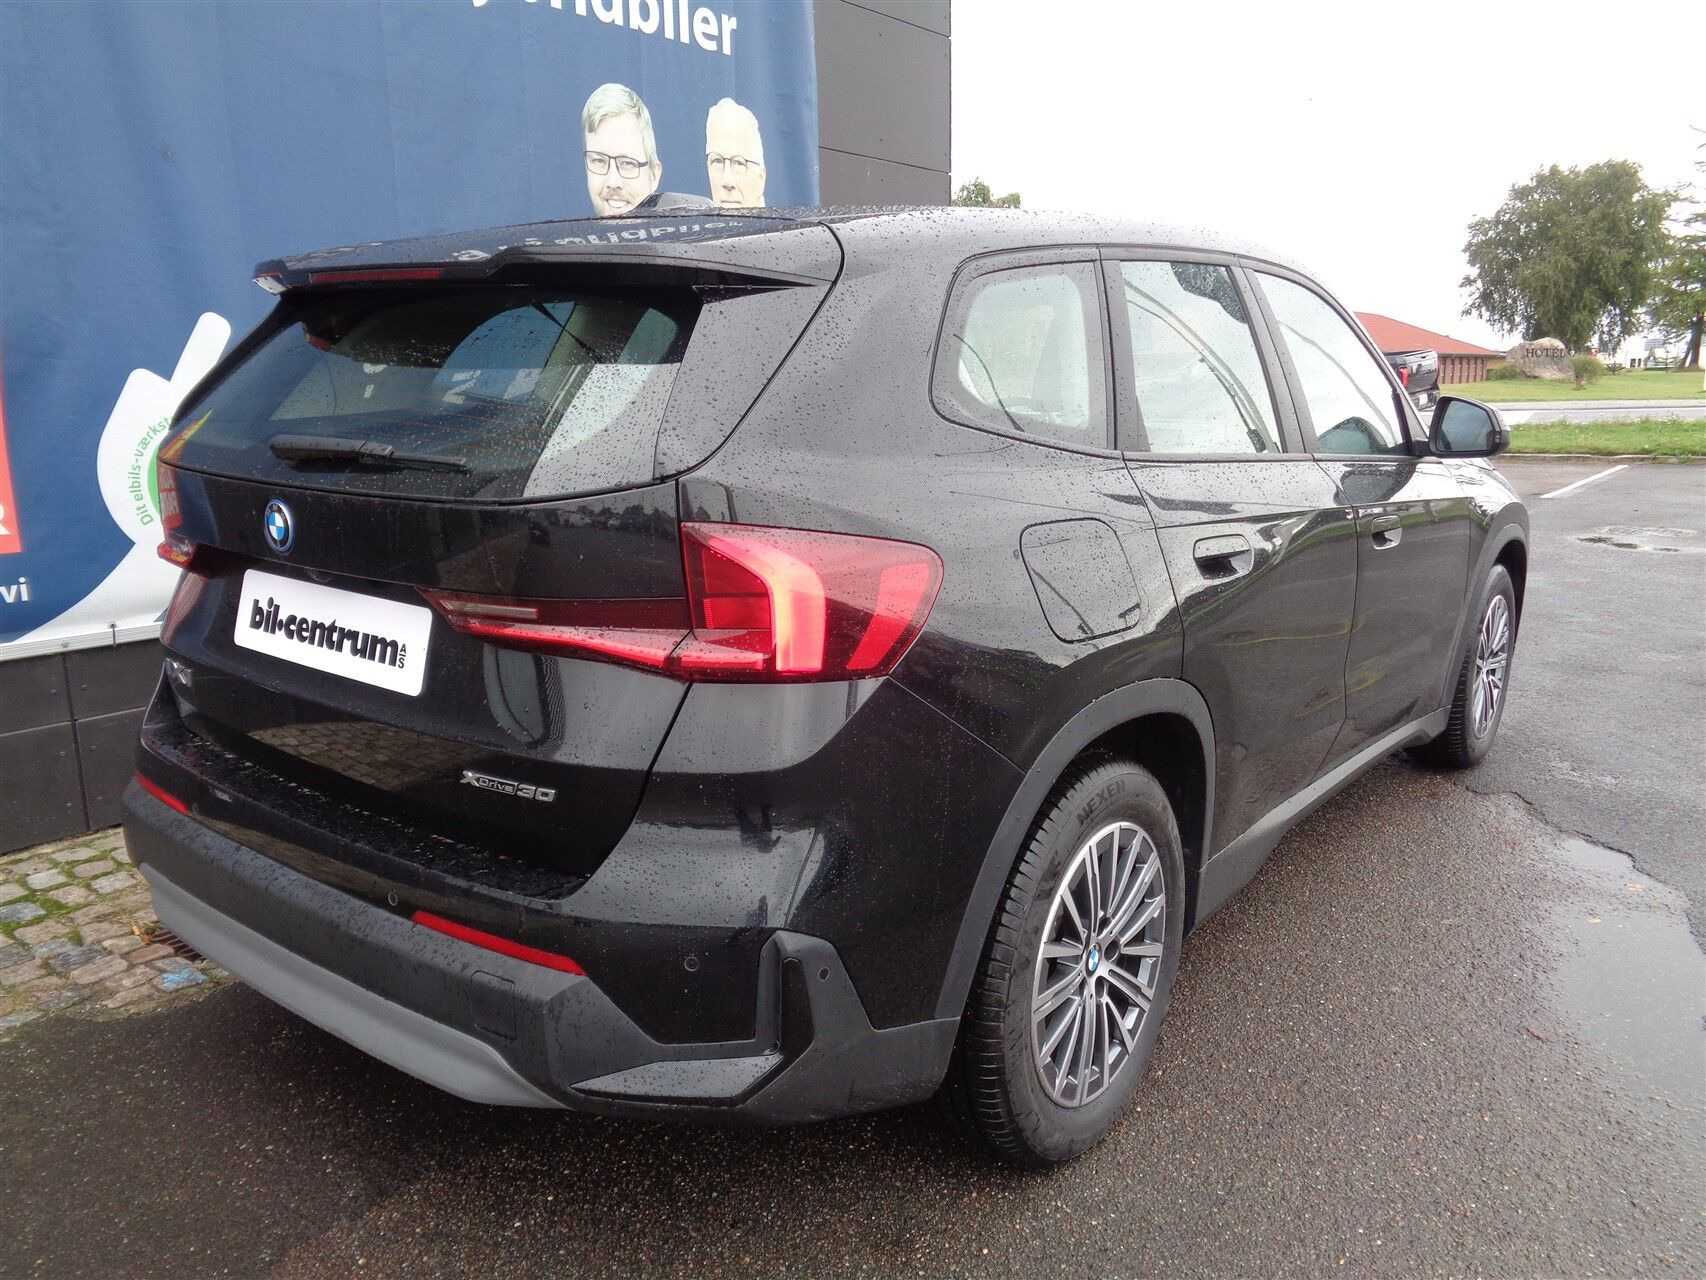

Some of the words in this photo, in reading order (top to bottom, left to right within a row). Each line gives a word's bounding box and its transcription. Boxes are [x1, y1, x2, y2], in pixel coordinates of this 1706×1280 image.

[1525, 348, 1567, 359] HOTEL
[135, 503, 154, 526] Dit
[1076, 779, 1127, 826] NEXEN
